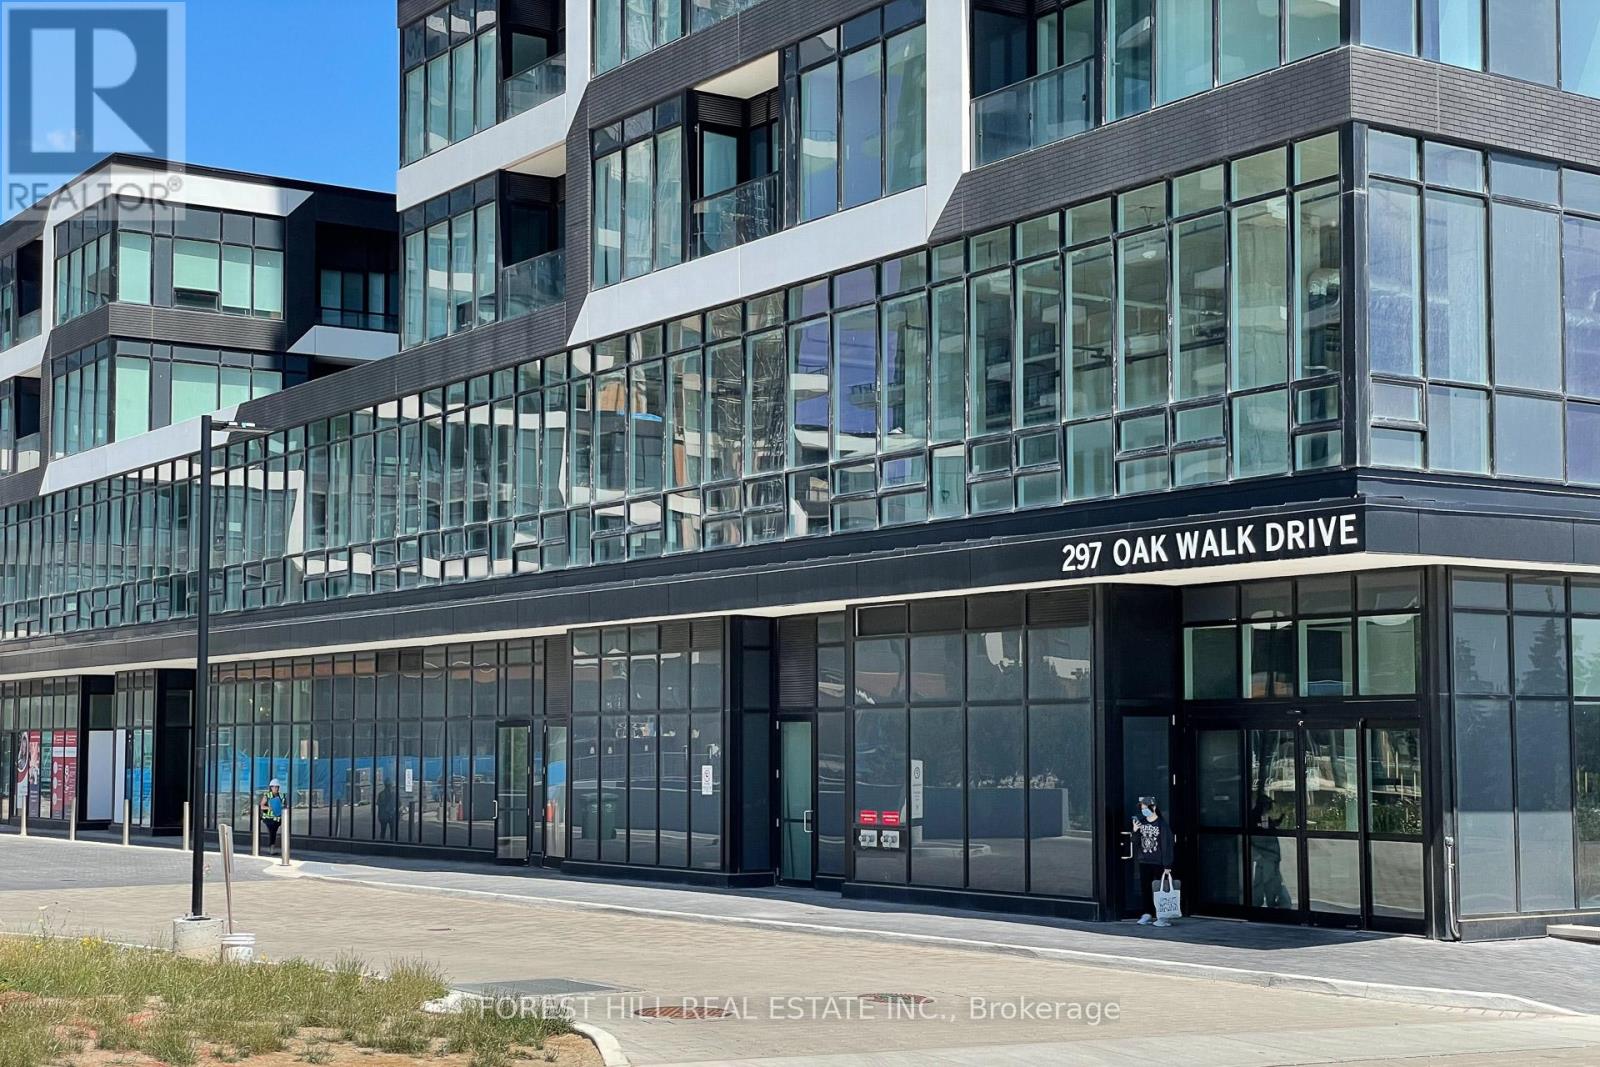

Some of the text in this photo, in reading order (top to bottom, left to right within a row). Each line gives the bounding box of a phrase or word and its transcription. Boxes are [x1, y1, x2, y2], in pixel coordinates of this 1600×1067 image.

[1061, 513, 1358, 572] 297 OAK WALK DRIVE
